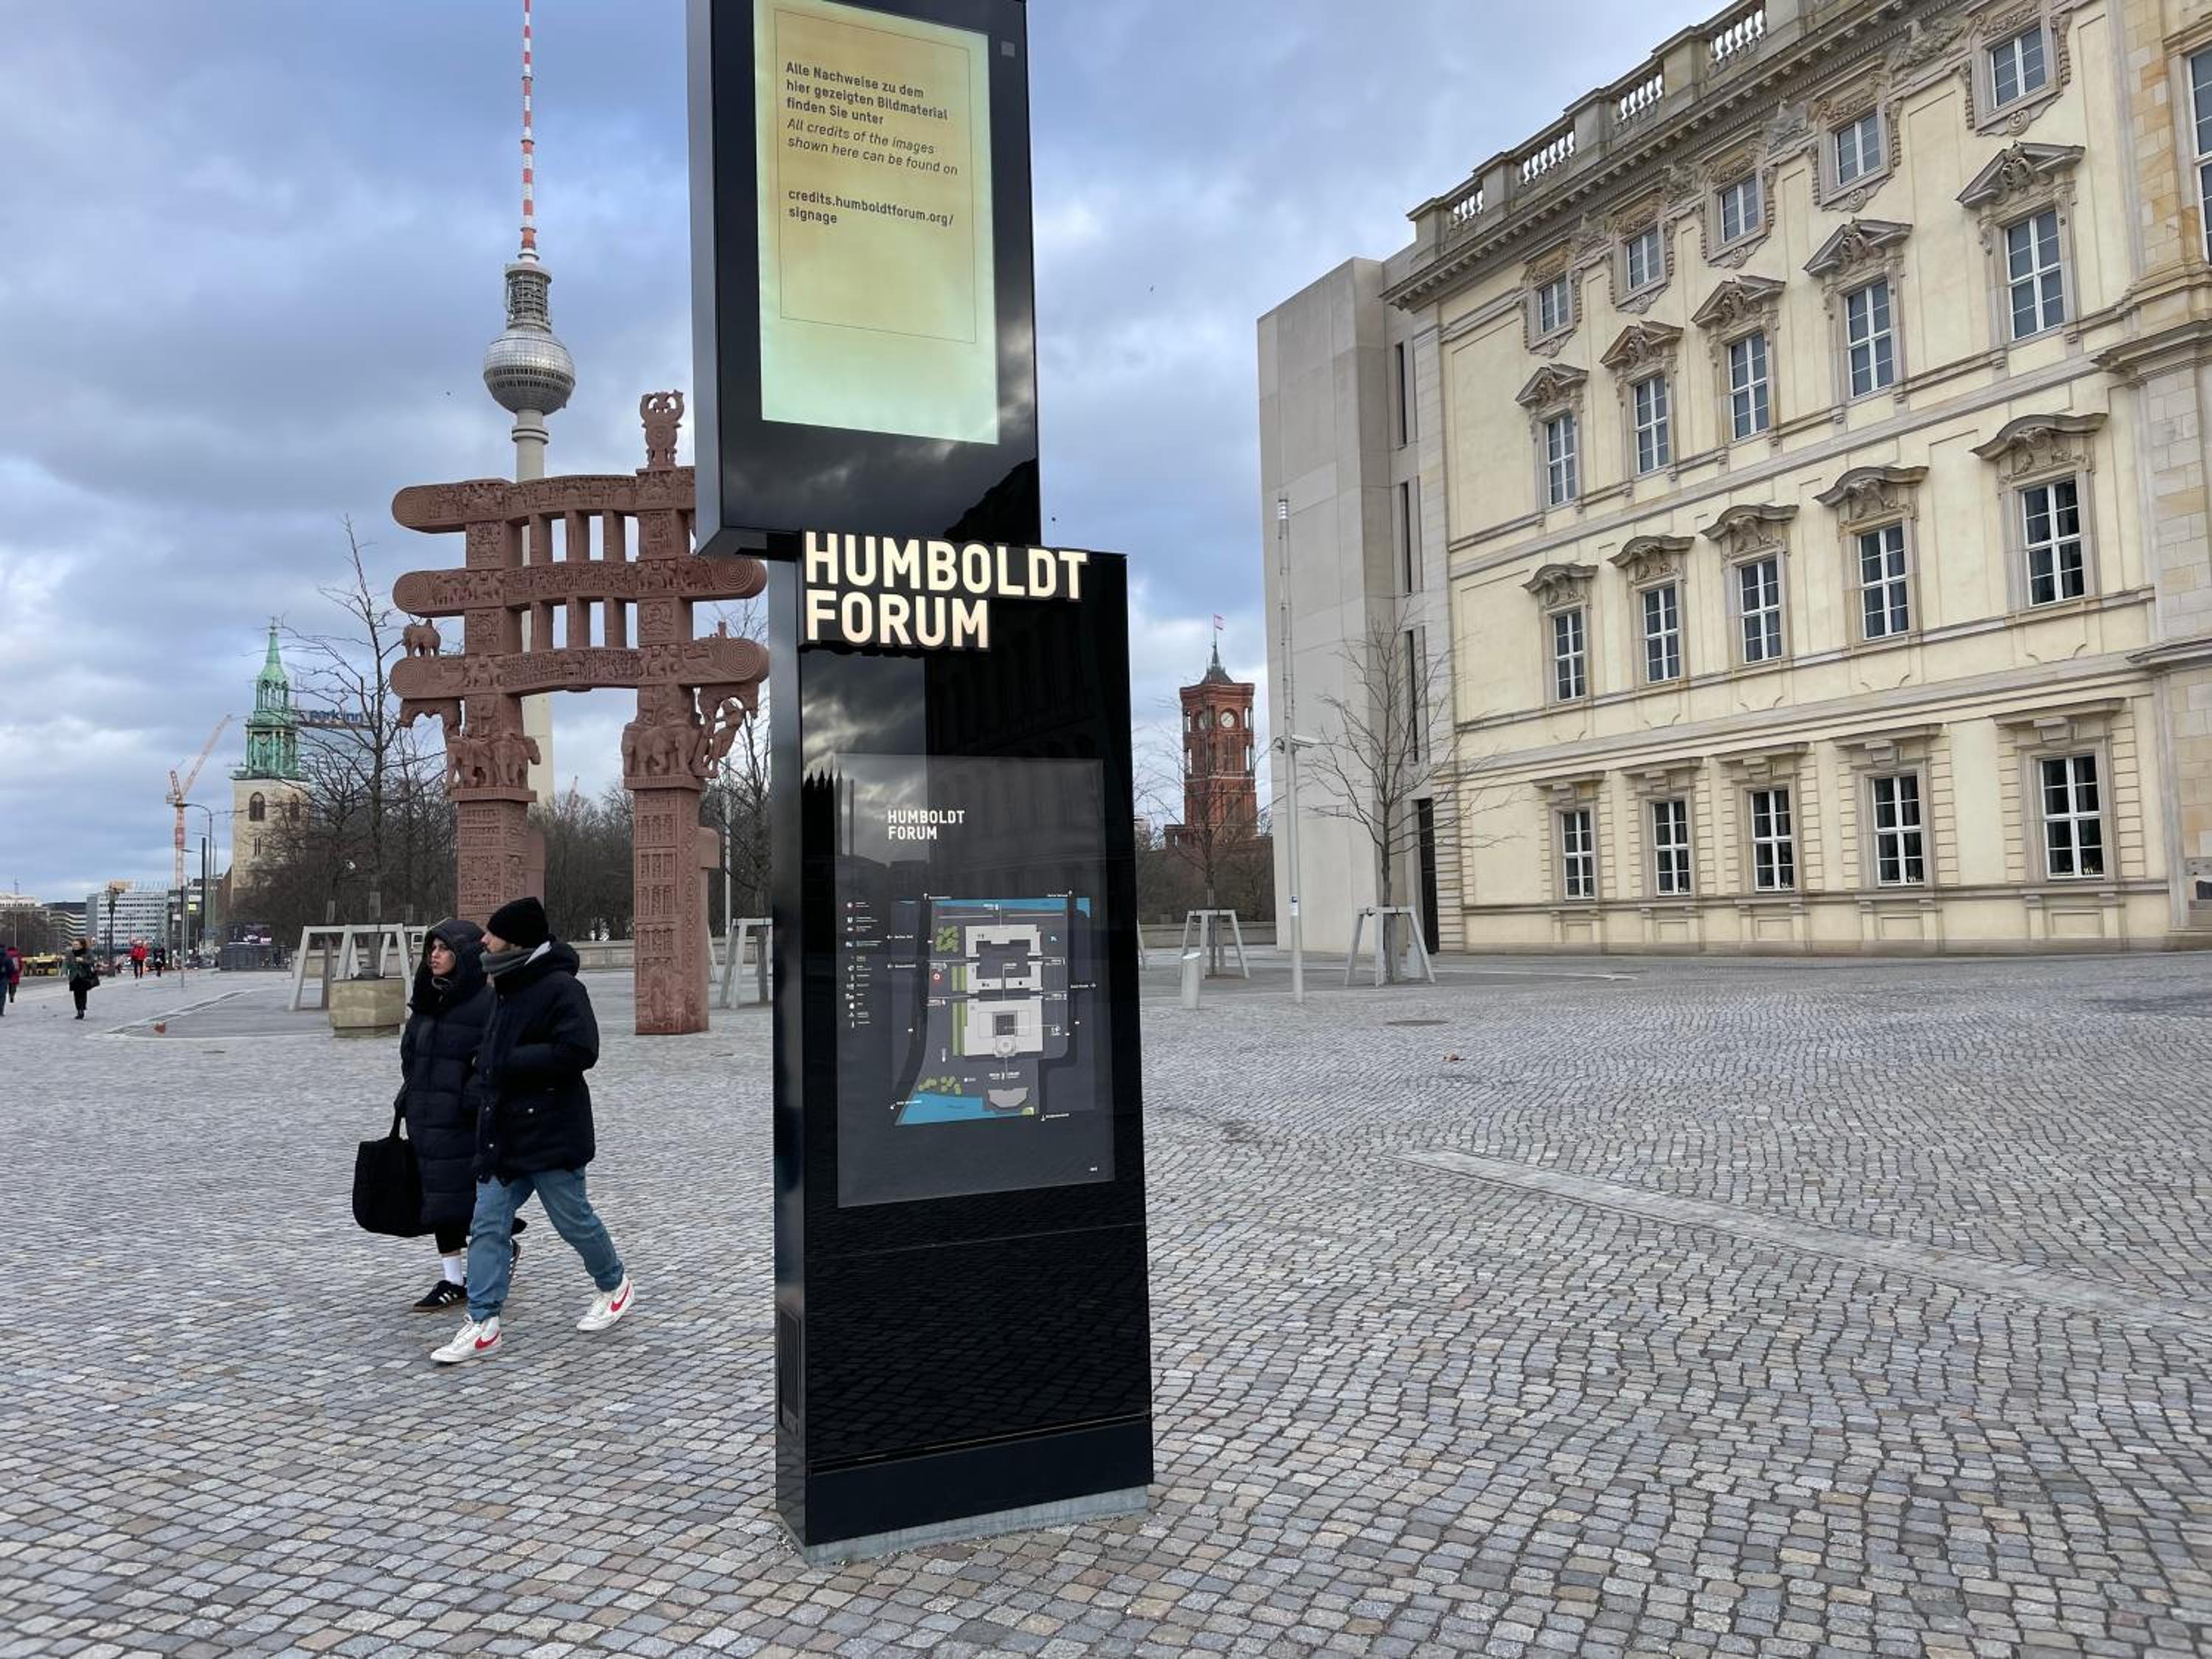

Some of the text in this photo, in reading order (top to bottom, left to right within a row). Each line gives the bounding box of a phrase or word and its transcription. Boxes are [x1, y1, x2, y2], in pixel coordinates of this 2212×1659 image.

[786, 62, 924, 98] Alle Nachweise zu dem
[787, 80, 947, 120] hier gezeigten Bildmaterial
[787, 98, 883, 125] finden Sie unter
[787, 119, 934, 154] All credits of the images
[788, 138, 958, 175] shown here can be found on
[788, 190, 953, 226] credits.humboldtforum.org/
[789, 207, 837, 224] signage
[805, 531, 1087, 599] HUMBOLDT
[806, 589, 988, 649] FORUM
[888, 810, 964, 824] HUMBOLDT
[888, 827, 937, 840] FORUM
